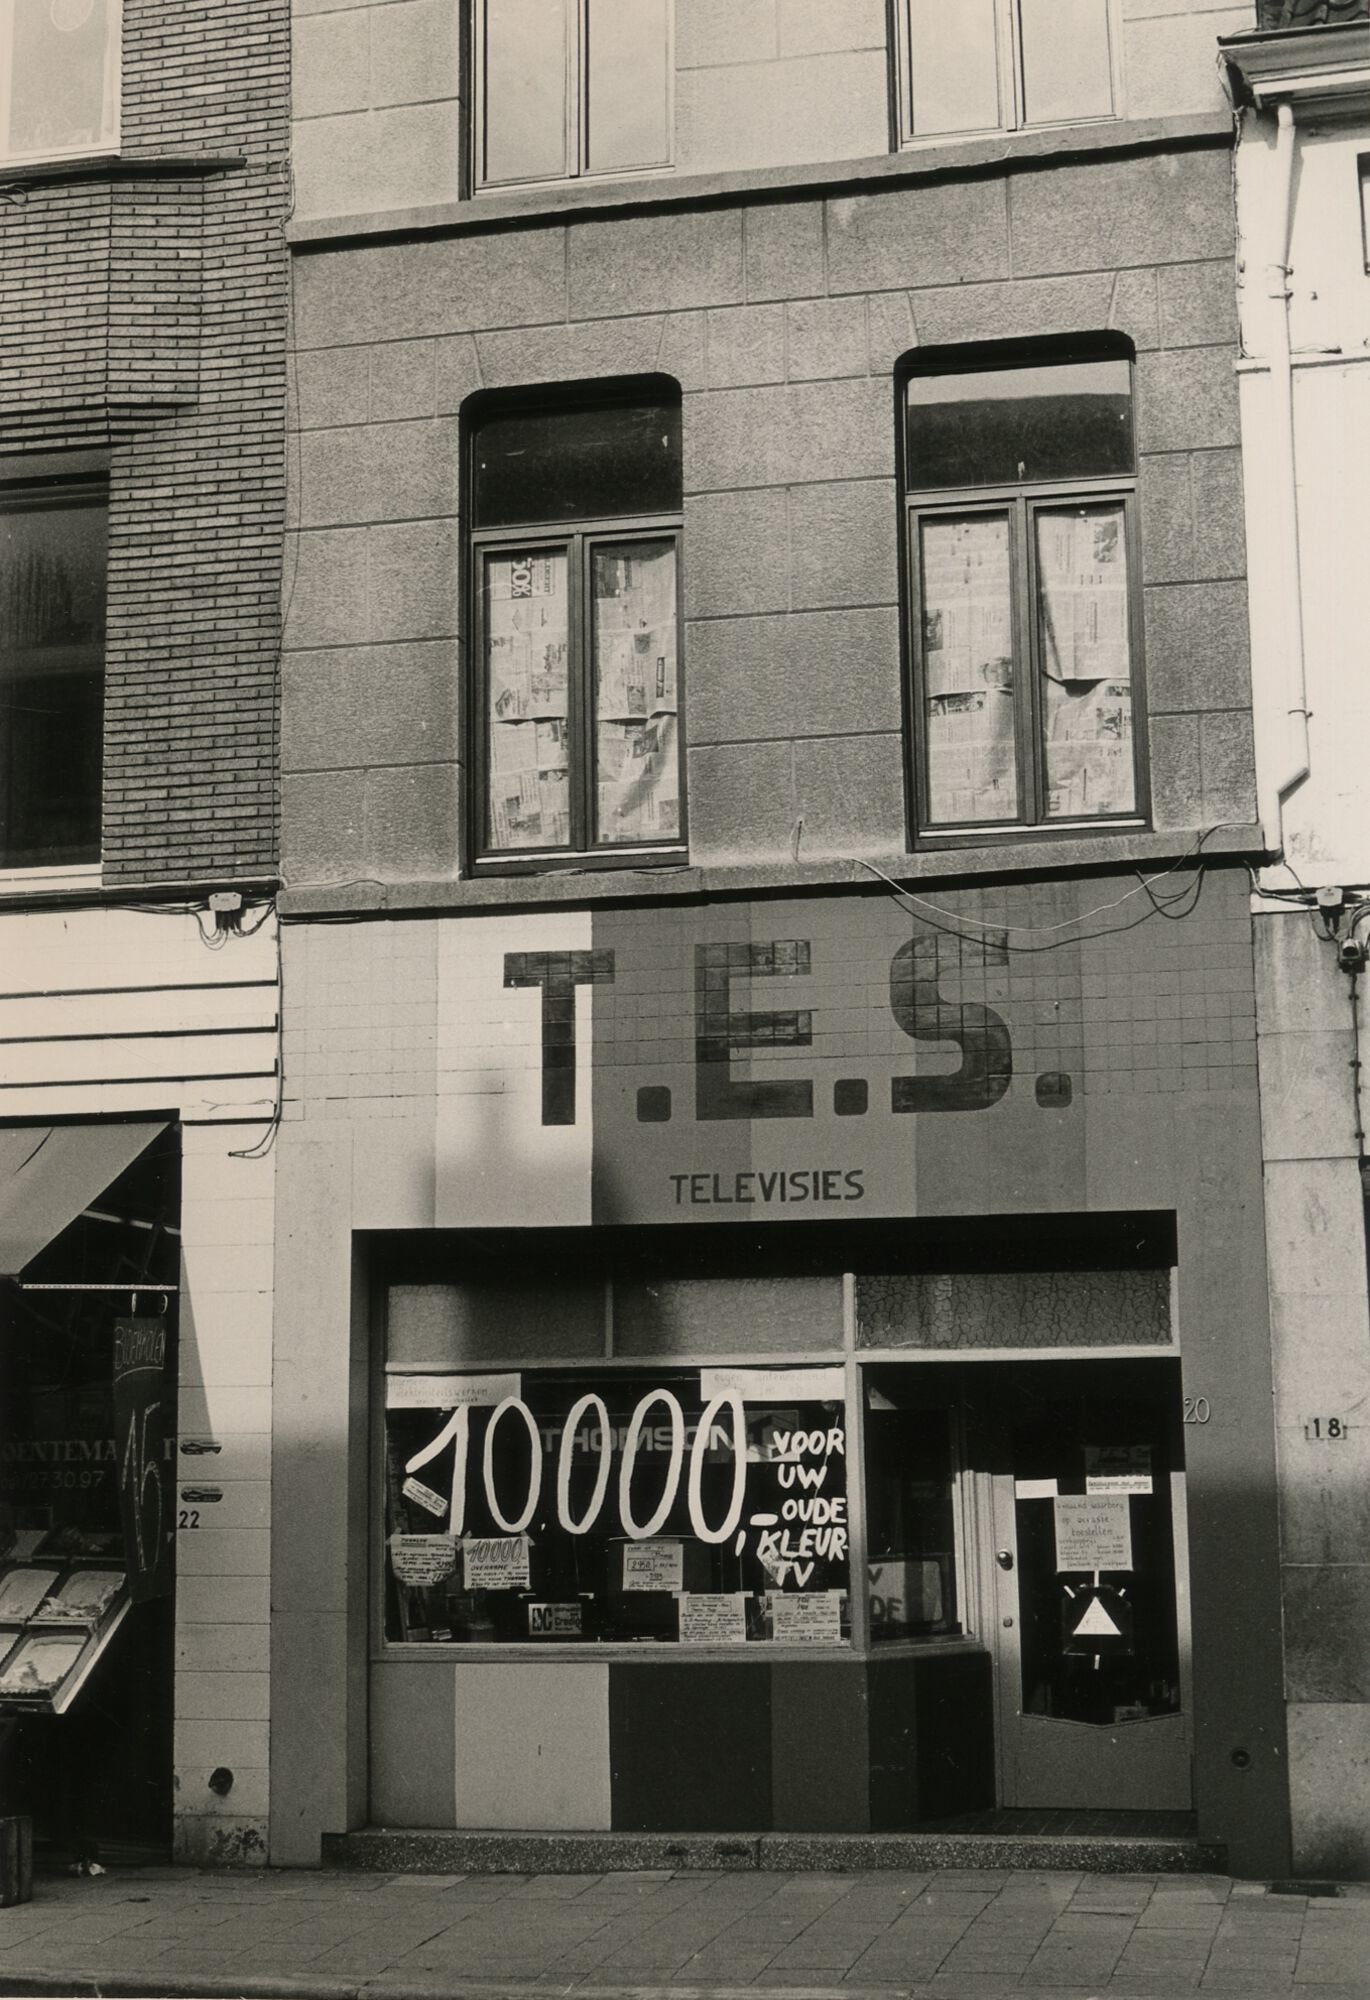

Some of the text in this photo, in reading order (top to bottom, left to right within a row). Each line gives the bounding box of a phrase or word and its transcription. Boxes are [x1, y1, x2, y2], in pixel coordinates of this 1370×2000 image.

[503, 930, 1073, 1126] T.E.S.
[669, 1170, 865, 1204] TELEVISIES
[1183, 1396, 1212, 1424] 20
[540, 1425, 740, 1453] THOMSON
[773, 1427, 845, 1456] VOOR
[1313, 1417, 1342, 1438] 18
[777, 1463, 828, 1490] UW
[179, 1510, 200, 1529] 22
[781, 1497, 847, 1526] OUDE
[770, 1560, 815, 1588] TV
